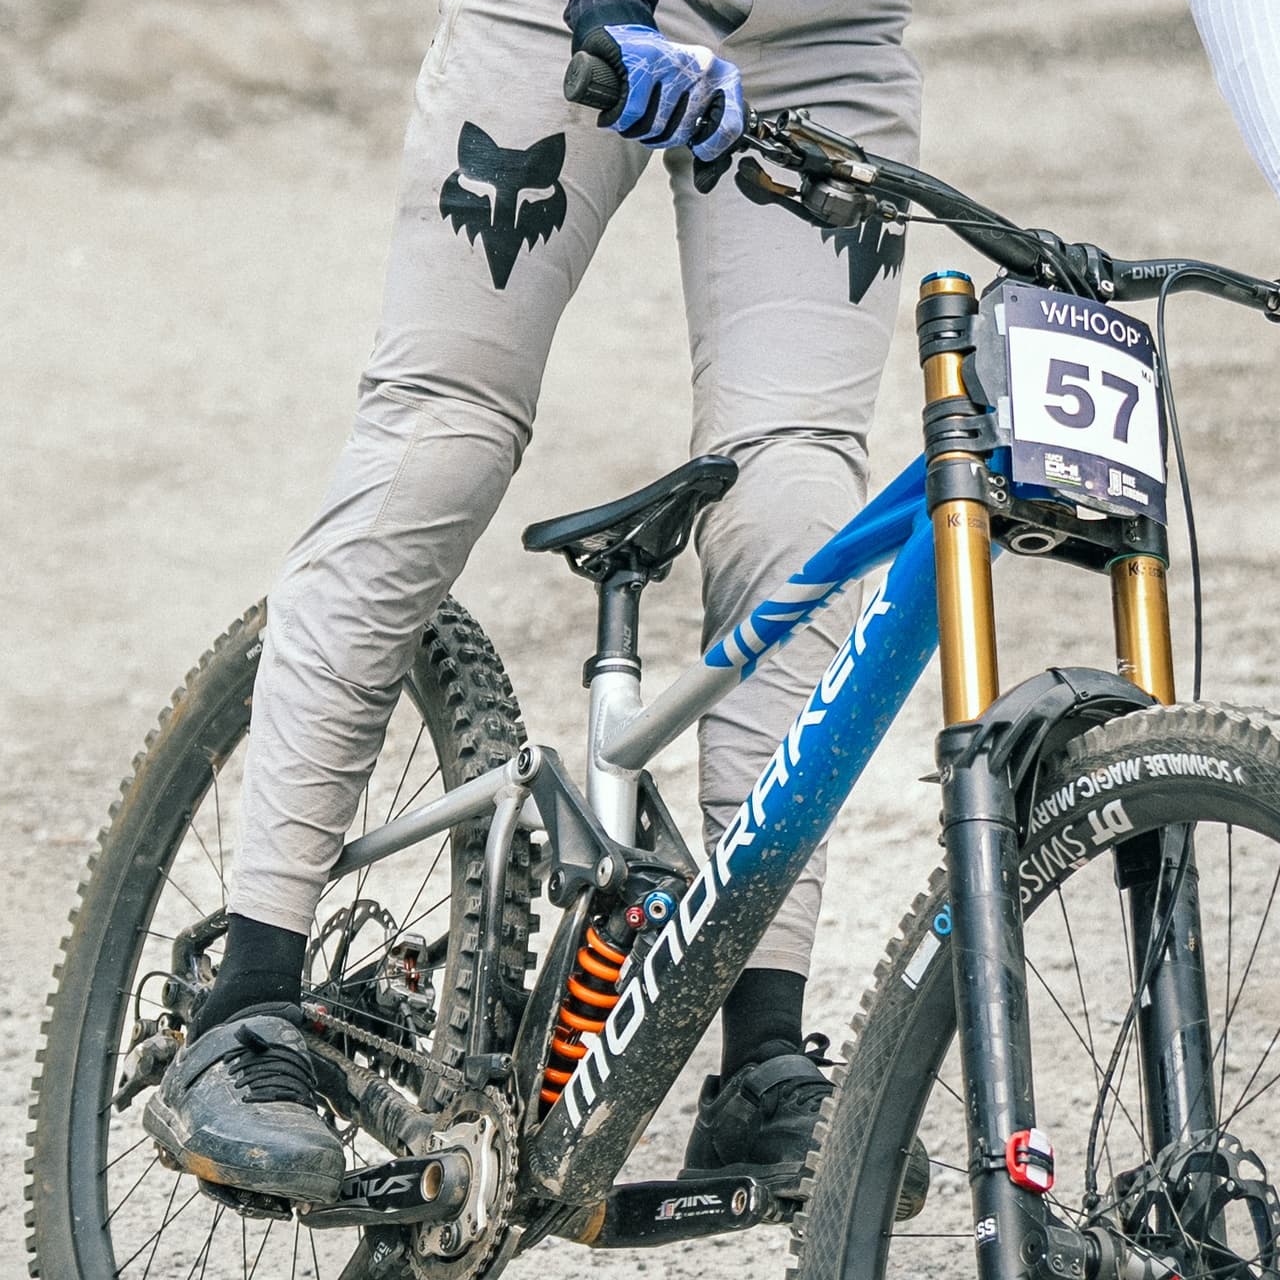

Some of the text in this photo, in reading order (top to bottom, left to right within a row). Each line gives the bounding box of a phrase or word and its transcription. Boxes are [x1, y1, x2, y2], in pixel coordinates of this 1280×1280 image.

[1040, 300, 1141, 347] WHOOP
[1044, 358, 1140, 444] 57
[1030, 753, 1233, 834] SCHWALBE MAGIC MARY
[1087, 799, 1135, 846] DT
